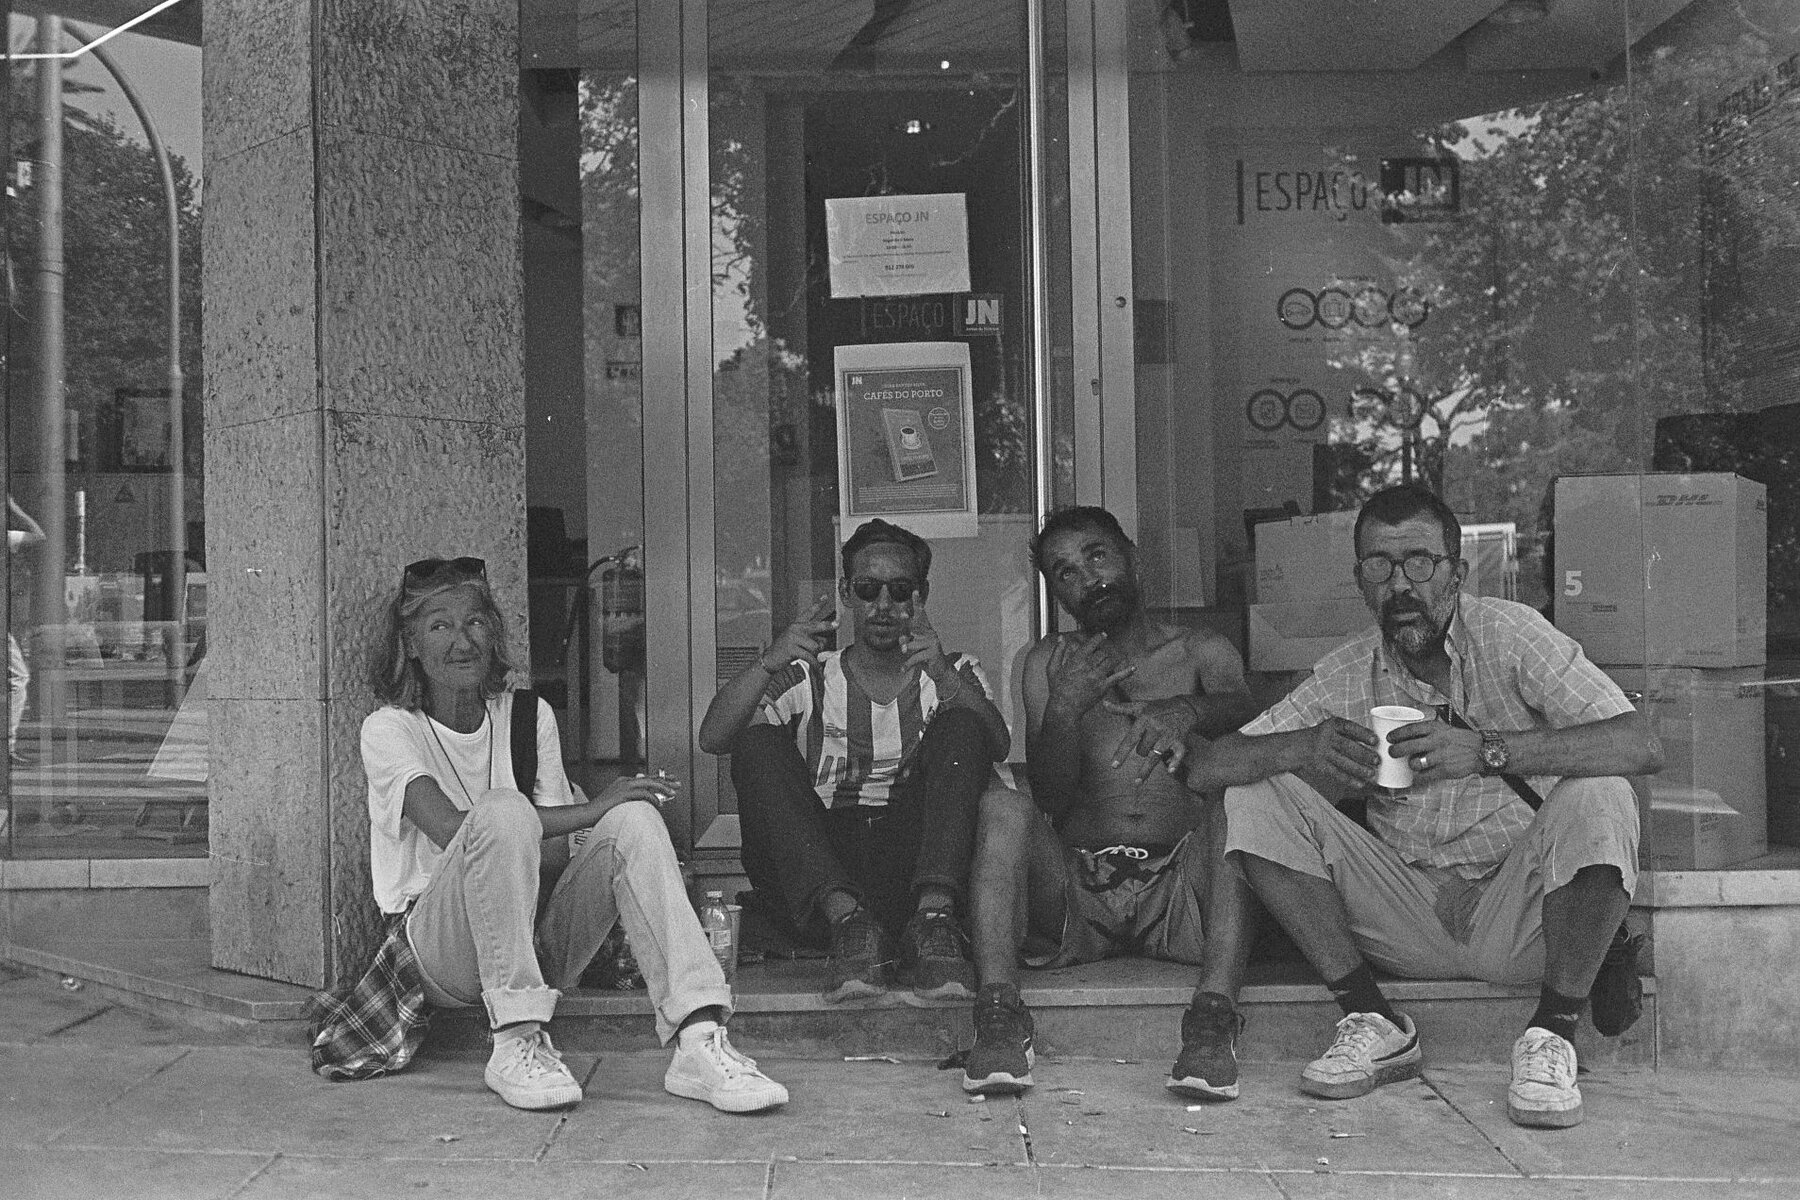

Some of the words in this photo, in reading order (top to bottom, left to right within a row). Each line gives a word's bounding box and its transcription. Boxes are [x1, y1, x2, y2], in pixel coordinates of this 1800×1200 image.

[1256, 171, 1368, 222] ESPAÇO
[865, 212, 911, 225] ESPAÇO
[873, 302, 945, 334] ESPAÇO
[965, 299, 1000, 325] JN
[895, 390, 909, 399] DO
[911, 389, 944, 399] PORTO
[1564, 570, 1583, 597] 5
